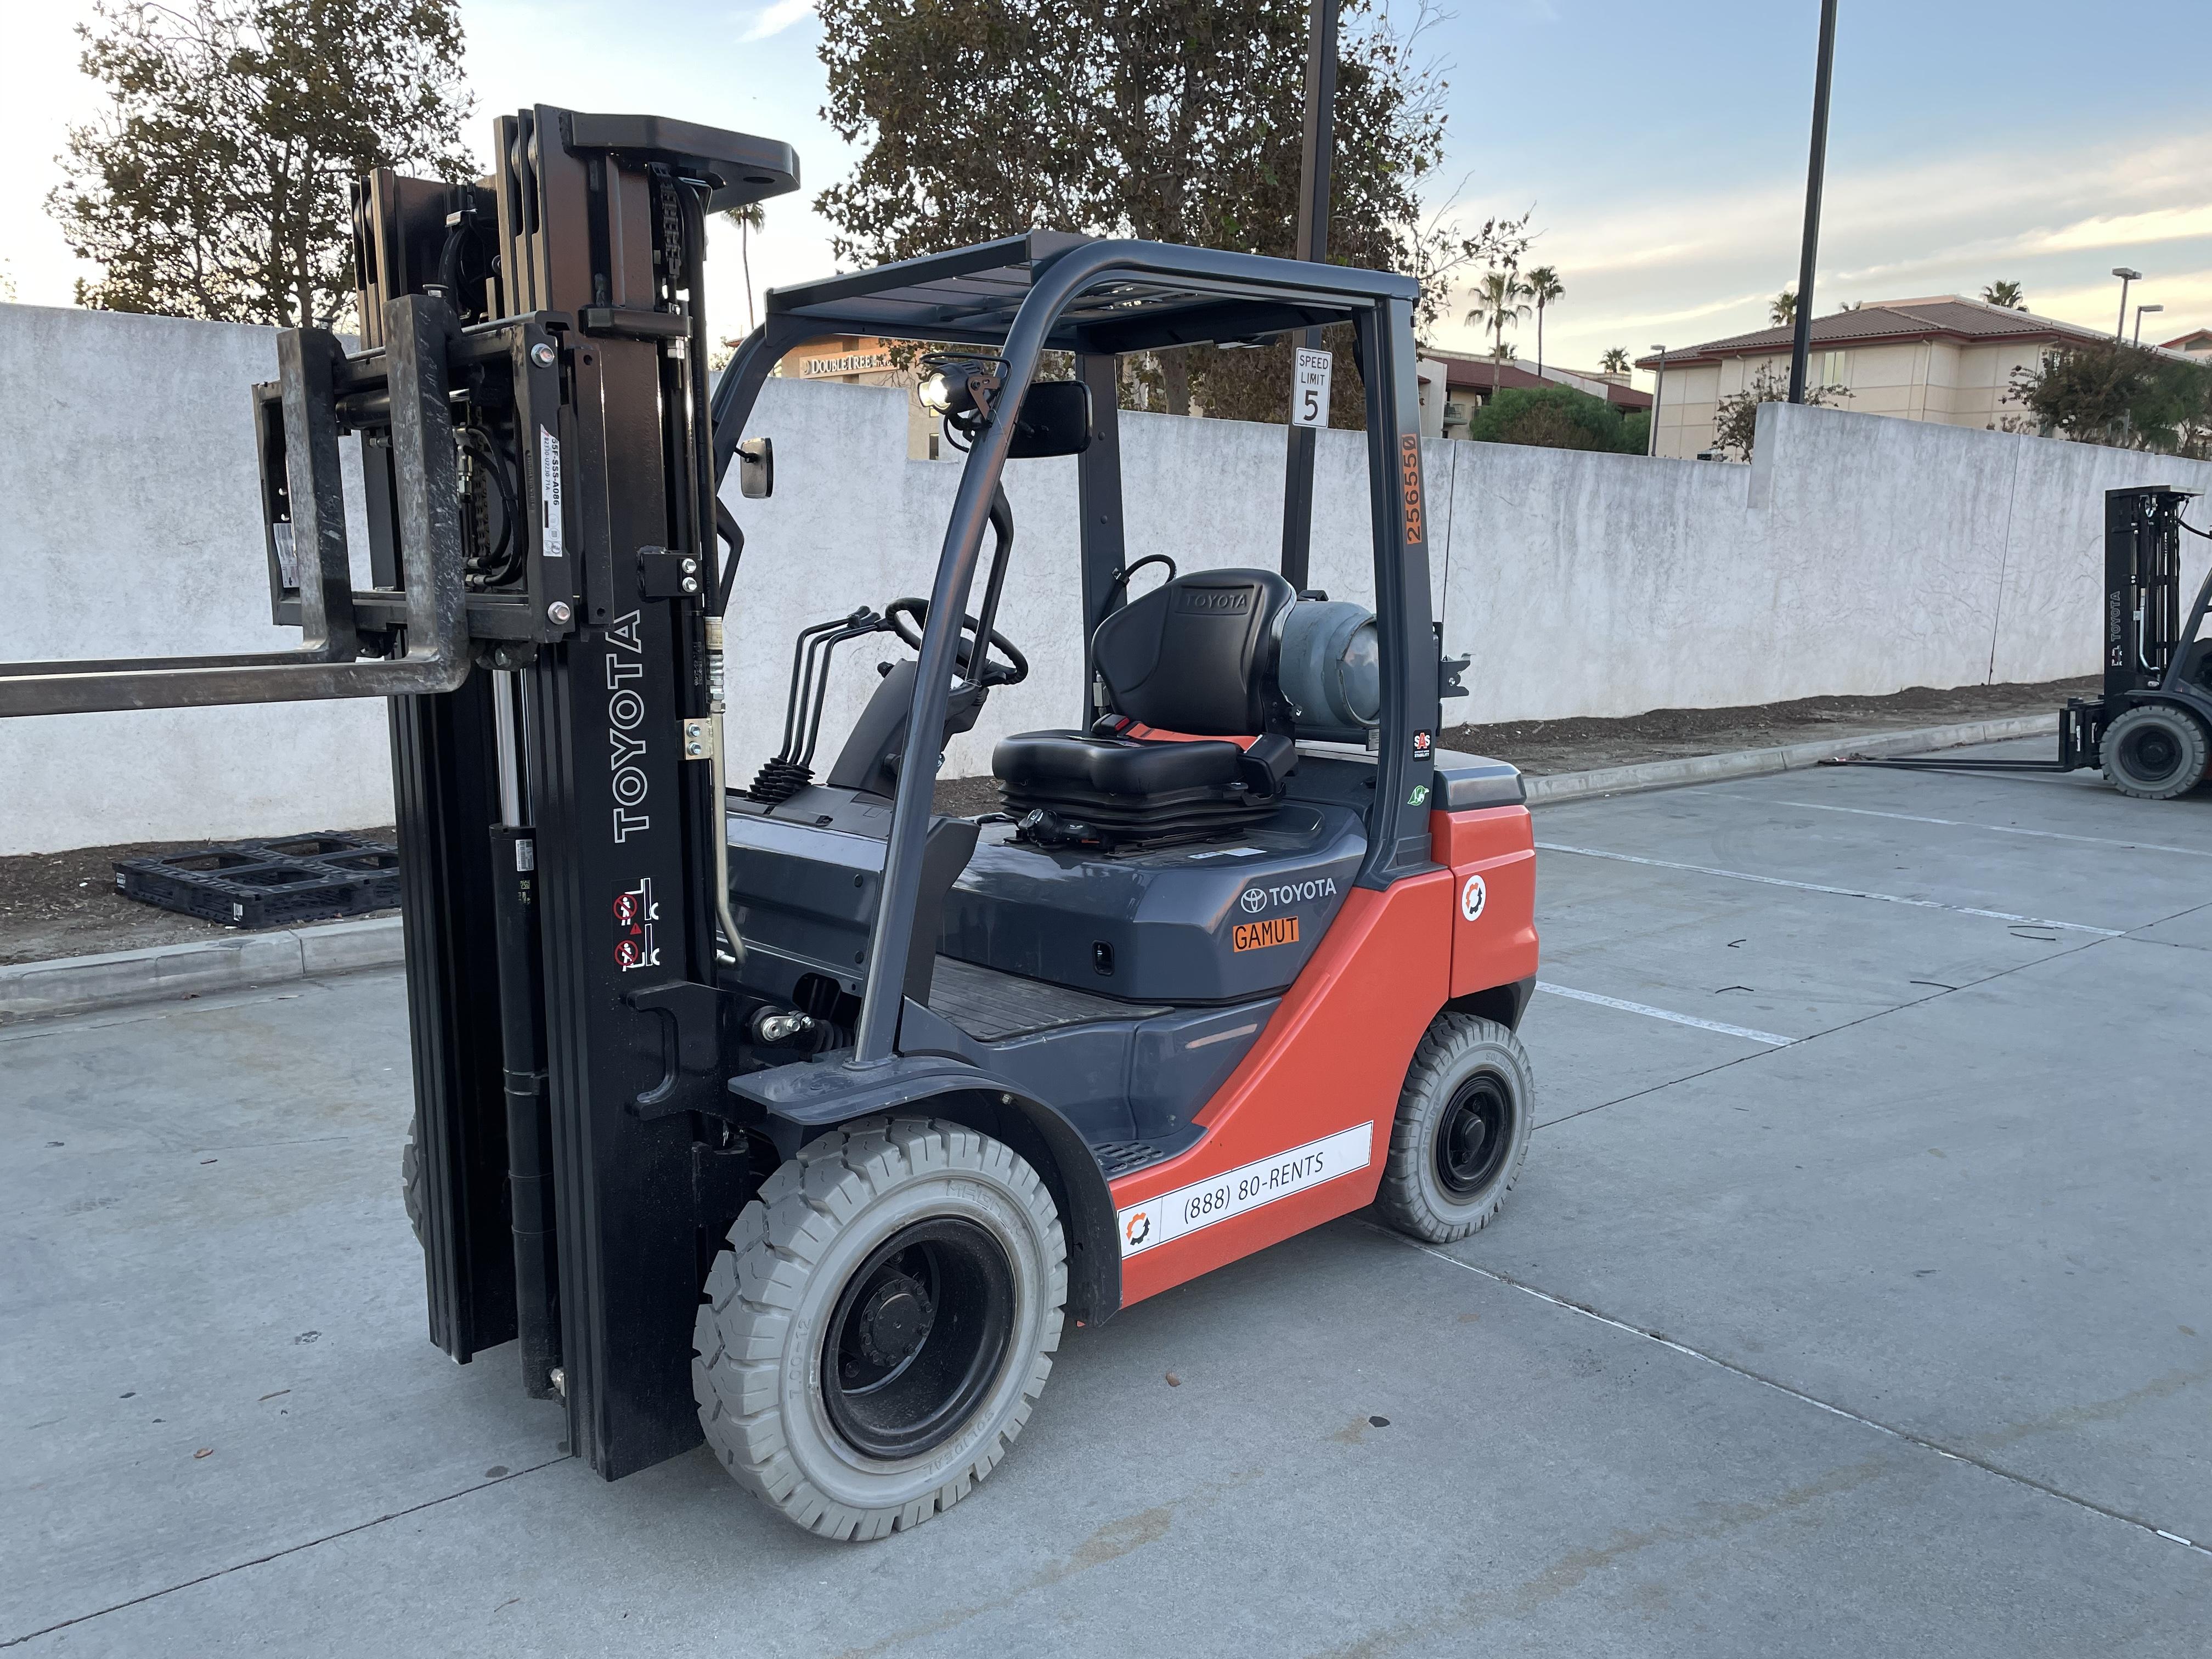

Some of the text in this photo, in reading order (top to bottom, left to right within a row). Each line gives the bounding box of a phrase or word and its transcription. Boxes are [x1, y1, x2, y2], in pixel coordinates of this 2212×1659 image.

[1299, 354, 1329, 370] SPEED
[1301, 371, 1325, 386] LIMIT
[1303, 390, 1318, 421] 5
[1402, 436, 1421, 541] 256550
[1185, 594, 1247, 609] TOYOTA
[2110, 590, 2121, 642] TOYOTA
[605, 609, 650, 844] TOYOTA
[1414, 732, 1431, 749] SAS
[1269, 877, 1338, 906] TOYOTA
[1235, 917, 1297, 950] GAMUT
[1184, 1152, 1324, 1224] (888) 80-RENTS
[789, 1318, 811, 1400] 7.00-12
[922, 1410, 995, 1475] SOLIDEAL
